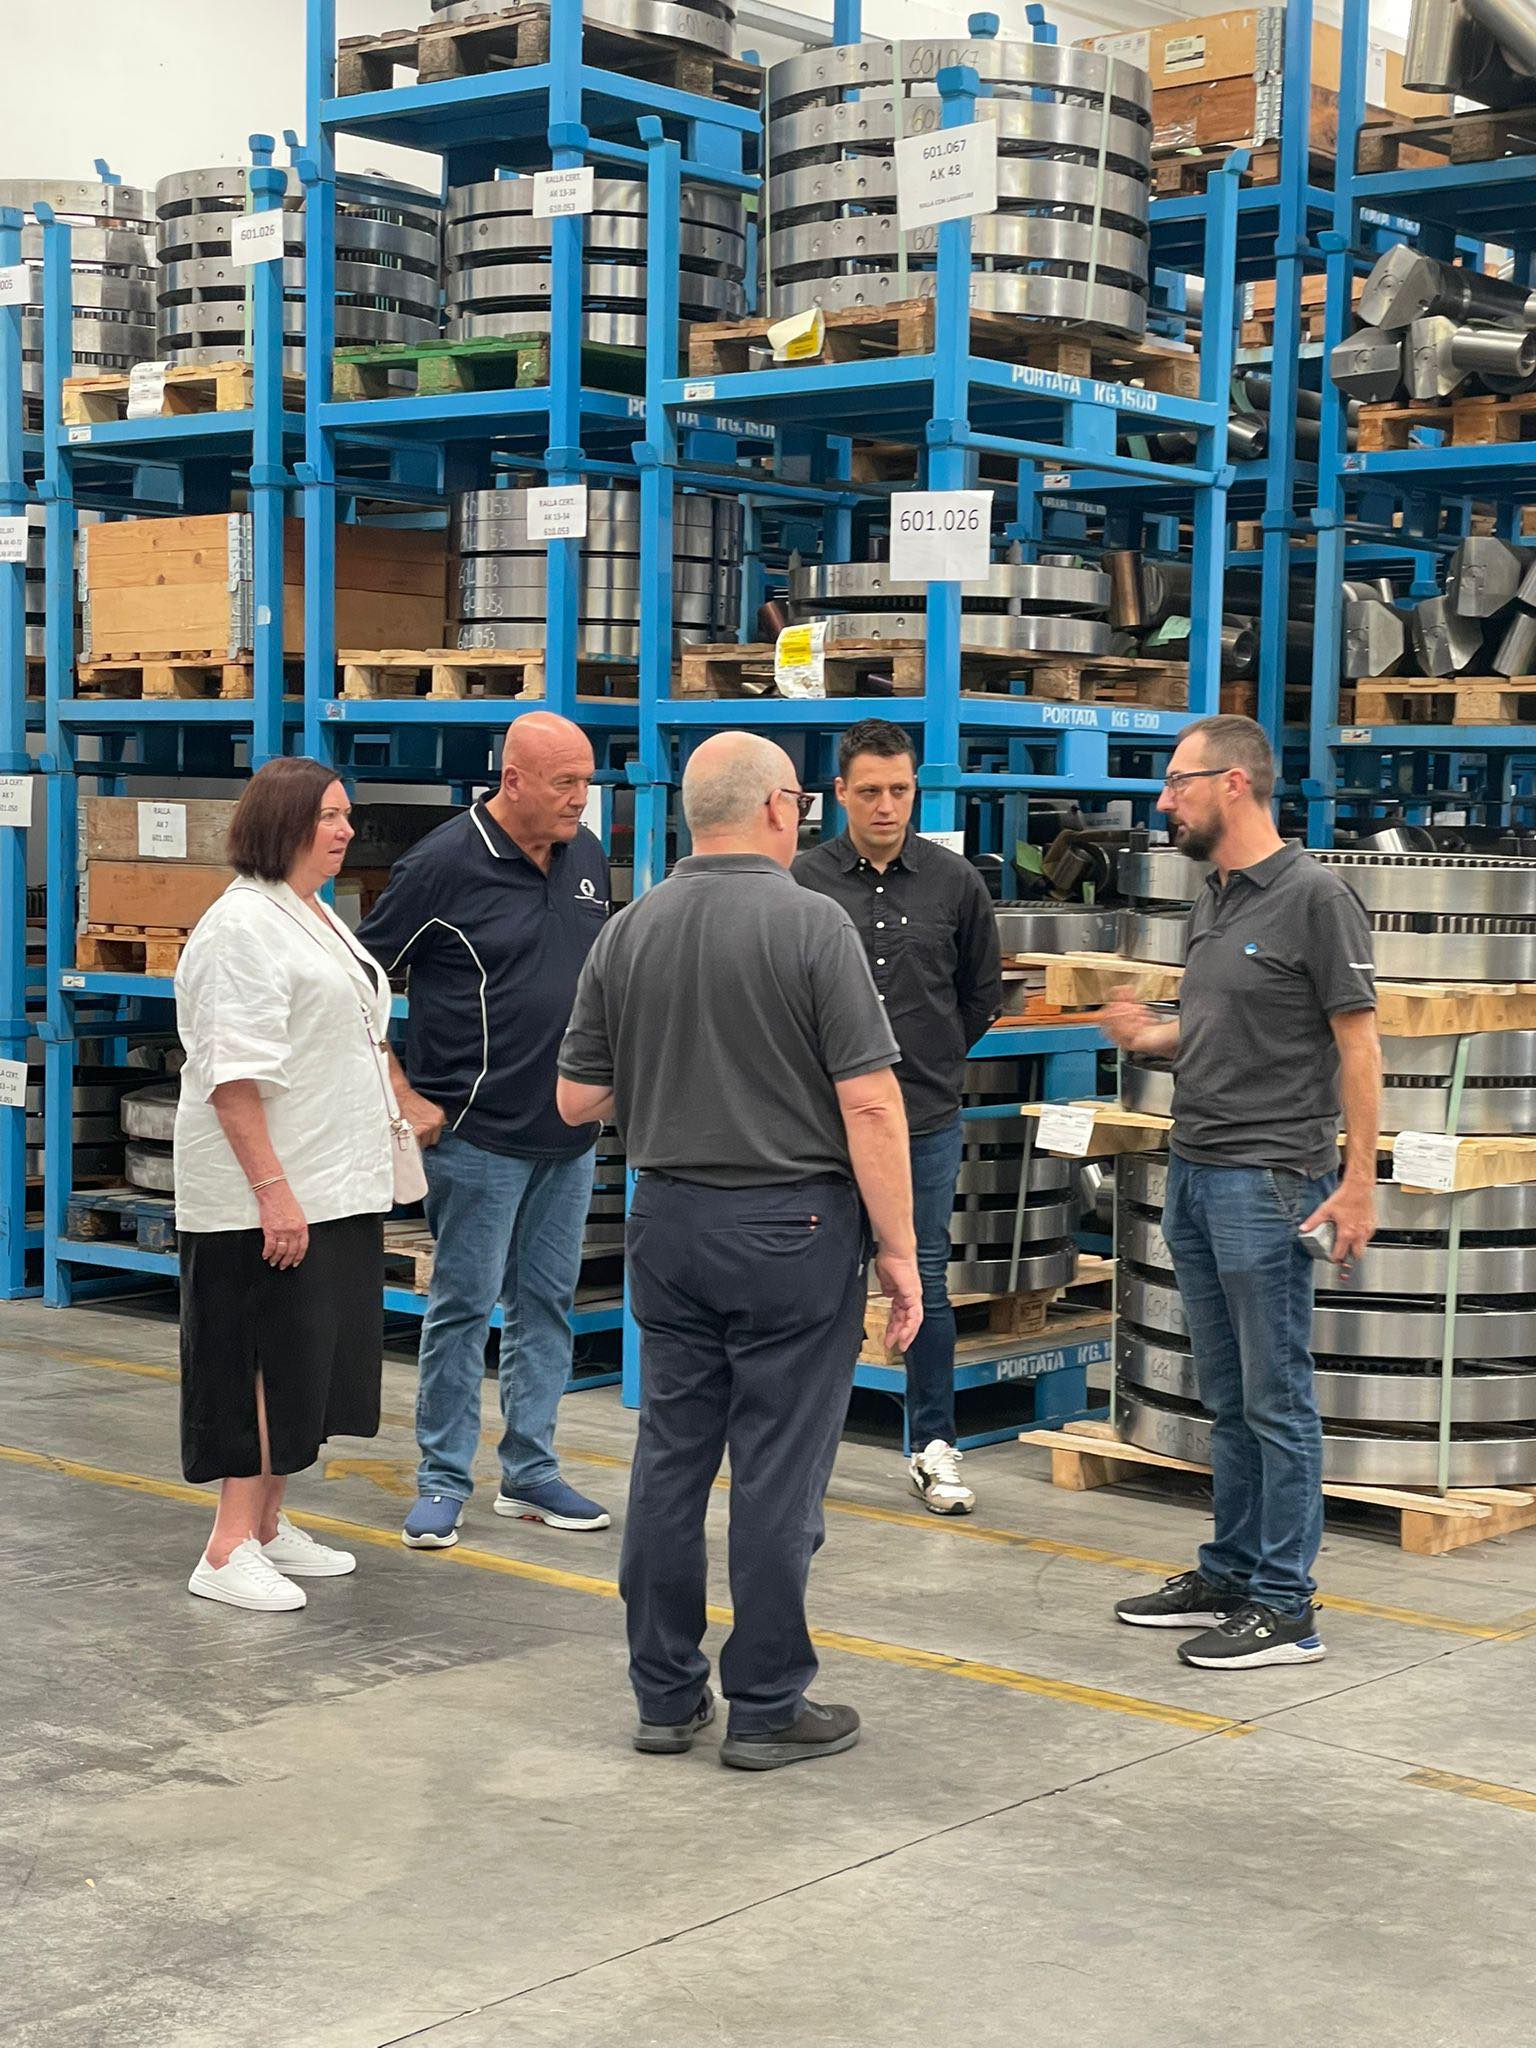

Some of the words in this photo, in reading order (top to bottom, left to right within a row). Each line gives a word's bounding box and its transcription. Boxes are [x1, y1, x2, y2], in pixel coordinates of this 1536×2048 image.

[922, 139, 967, 160] 601.067
[929, 166, 946, 182] AK
[948, 164, 962, 176] 48
[240, 224, 276, 241] 601.026
[1011, 364, 1082, 396] PORTATA
[1093, 383, 1158, 412] KG.1500
[900, 508, 979, 532] 601.026
[1042, 706, 1099, 727] PORTATA
[1111, 710, 1130, 728] KG
[1134, 713, 1160, 730] 1500
[996, 1351, 1066, 1381] PORTATA
[1077, 1341, 1112, 1364] KG.1
